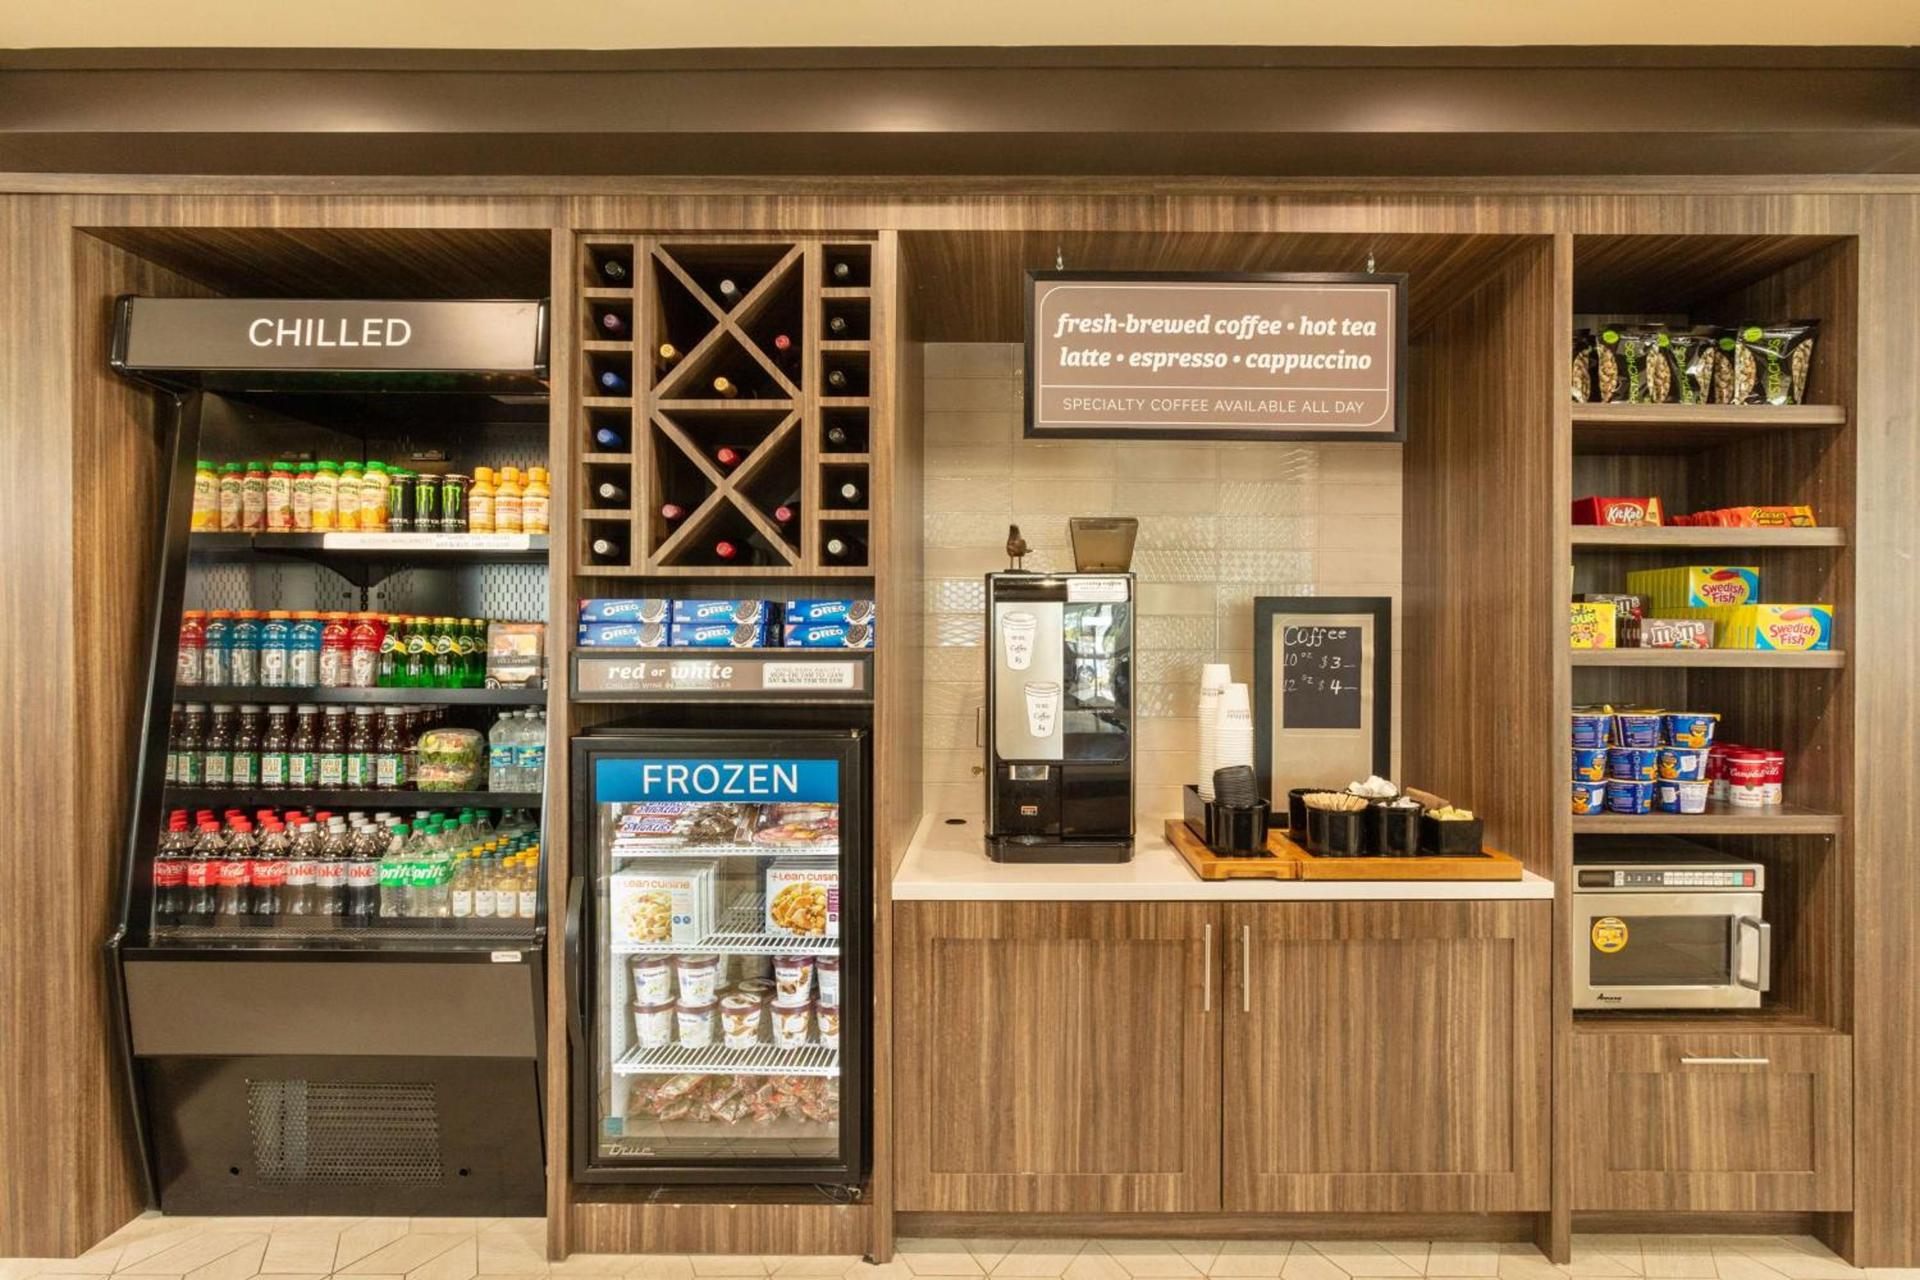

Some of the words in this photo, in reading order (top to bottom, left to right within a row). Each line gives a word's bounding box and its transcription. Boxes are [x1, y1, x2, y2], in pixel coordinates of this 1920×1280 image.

[248, 318, 412, 348] CHILLED
[1054, 313, 1209, 338] fresh-brewed
[1214, 315, 1282, 340] coffee
[1300, 317, 1337, 336] hot
[1342, 319, 1377, 336] tea
[1060, 347, 1110, 367] latte
[1129, 352, 1229, 372] espresso
[1245, 350, 1372, 374] cappuccino
[1062, 398, 1145, 411] SPECIALTY
[1150, 398, 1209, 412] COFFEE
[1214, 399, 1297, 413] AVAILABLE
[1301, 400, 1329, 413] ALL
[1335, 401, 1364, 414] DAY
[1701, 582, 1745, 597] Swedish
[1712, 592, 1736, 604] Fish
[603, 604, 639, 616] OREO
[697, 604, 733, 617] OREO
[810, 604, 846, 618] OREO
[1571, 613, 1597, 624] OUR
[601, 628, 637, 641] OREO
[695, 628, 731, 641] OREO
[808, 628, 844, 641] OREO
[1769, 624, 1816, 638] Swedish
[1780, 634, 1806, 646] Fish
[608, 662, 646, 679] red
[650, 668, 666, 677] or
[670, 661, 733, 679] white
[642, 764, 798, 795] FROZEN
[289, 864, 315, 876] oke
[318, 864, 343, 877] oke
[350, 865, 375, 877] oke
[380, 863, 412, 879] prite
[412, 863, 447, 879] prite
[806, 873, 839, 882] cuisin
